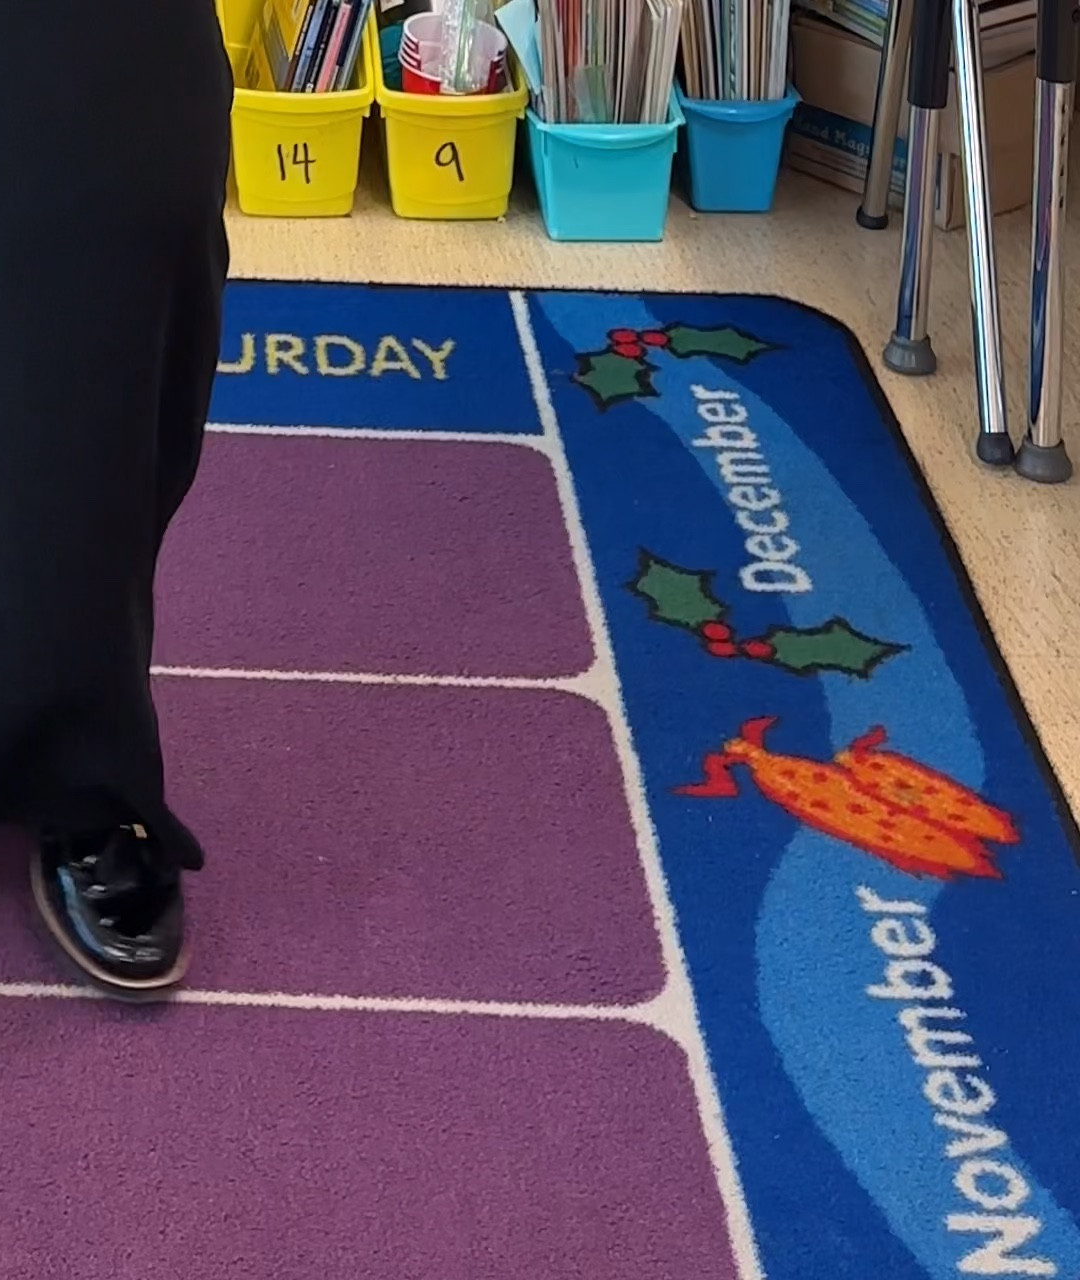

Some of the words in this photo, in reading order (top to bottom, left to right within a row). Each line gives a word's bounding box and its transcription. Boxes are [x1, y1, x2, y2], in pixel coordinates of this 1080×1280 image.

[276, 142, 316, 185] 14
[434, 140, 465, 183] 9
[691, 384, 812, 596] December
[855, 885, 1057, 1277] November
